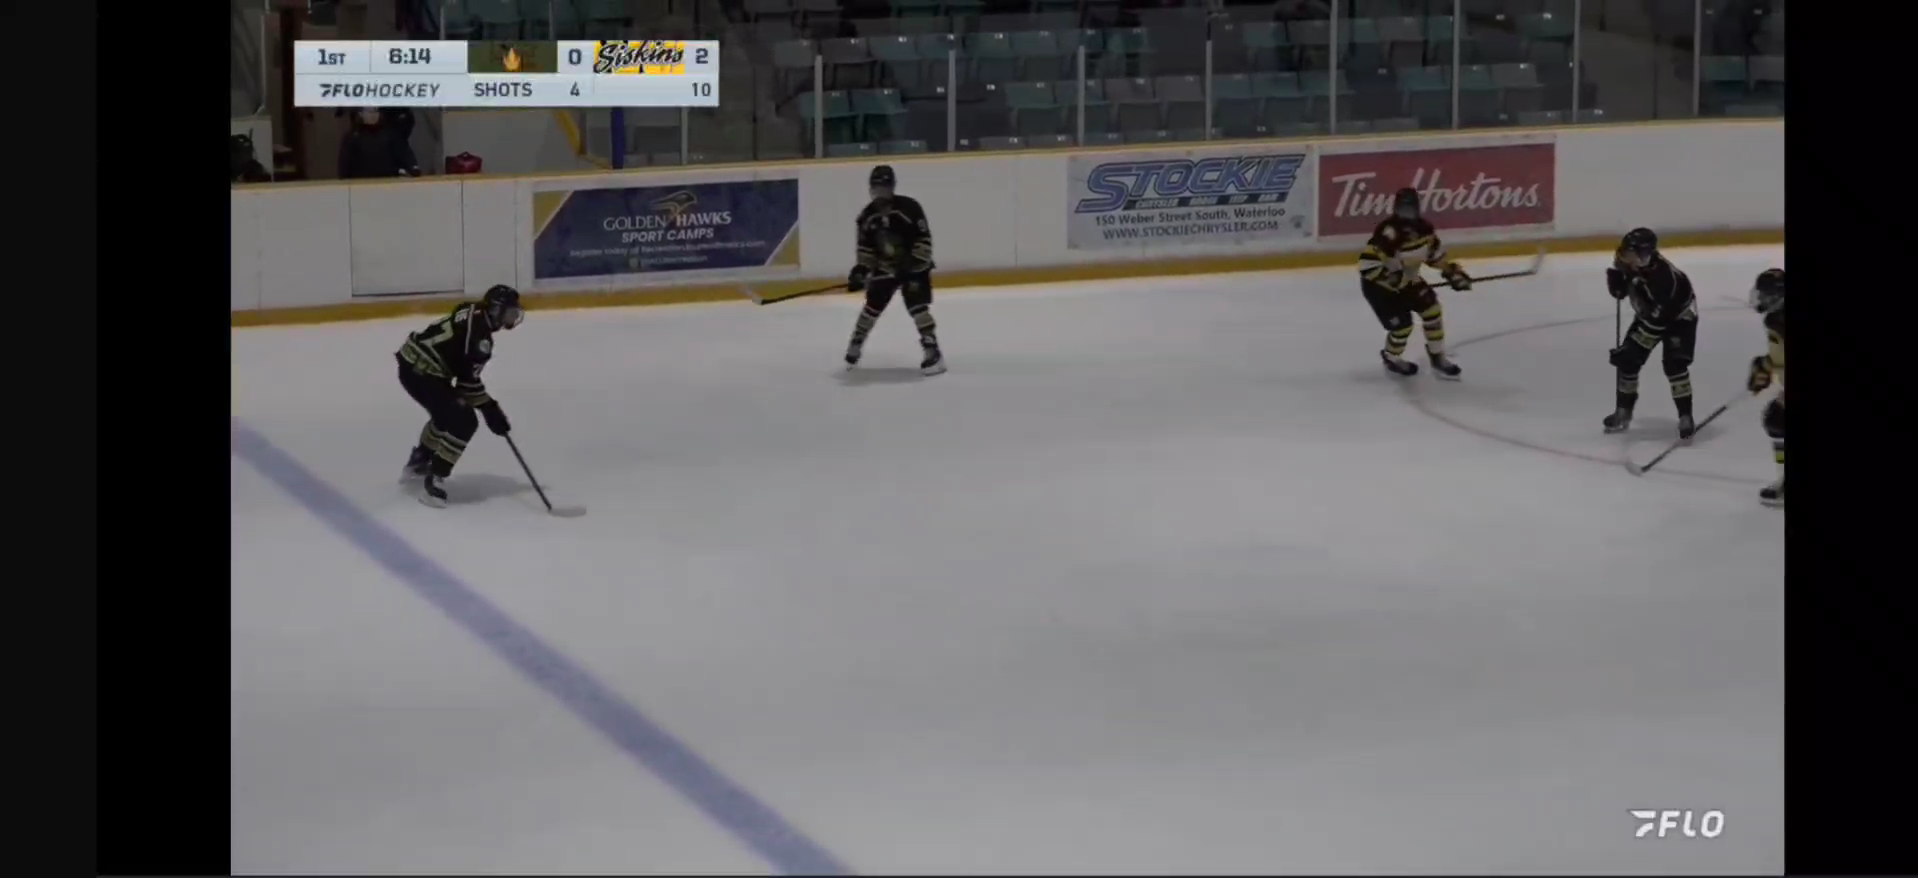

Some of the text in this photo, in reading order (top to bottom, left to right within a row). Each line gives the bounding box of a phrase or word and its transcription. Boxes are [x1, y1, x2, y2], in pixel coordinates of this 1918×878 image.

[1074, 153, 1307, 213] STOCKIE
[1331, 167, 1540, 217] Tim Hortons
[603, 211, 732, 231] GOLDEN HAWKS
[1095, 215, 1116, 226] 150
[1119, 213, 1155, 225] Weber
[1158, 211, 1192, 223] Street
[1233, 207, 1286, 219] Waterloo
[621, 228, 715, 243] SPORT CAMPS
[1102, 221, 1279, 240] WWW.STOCKIECHRYSLER.COM
